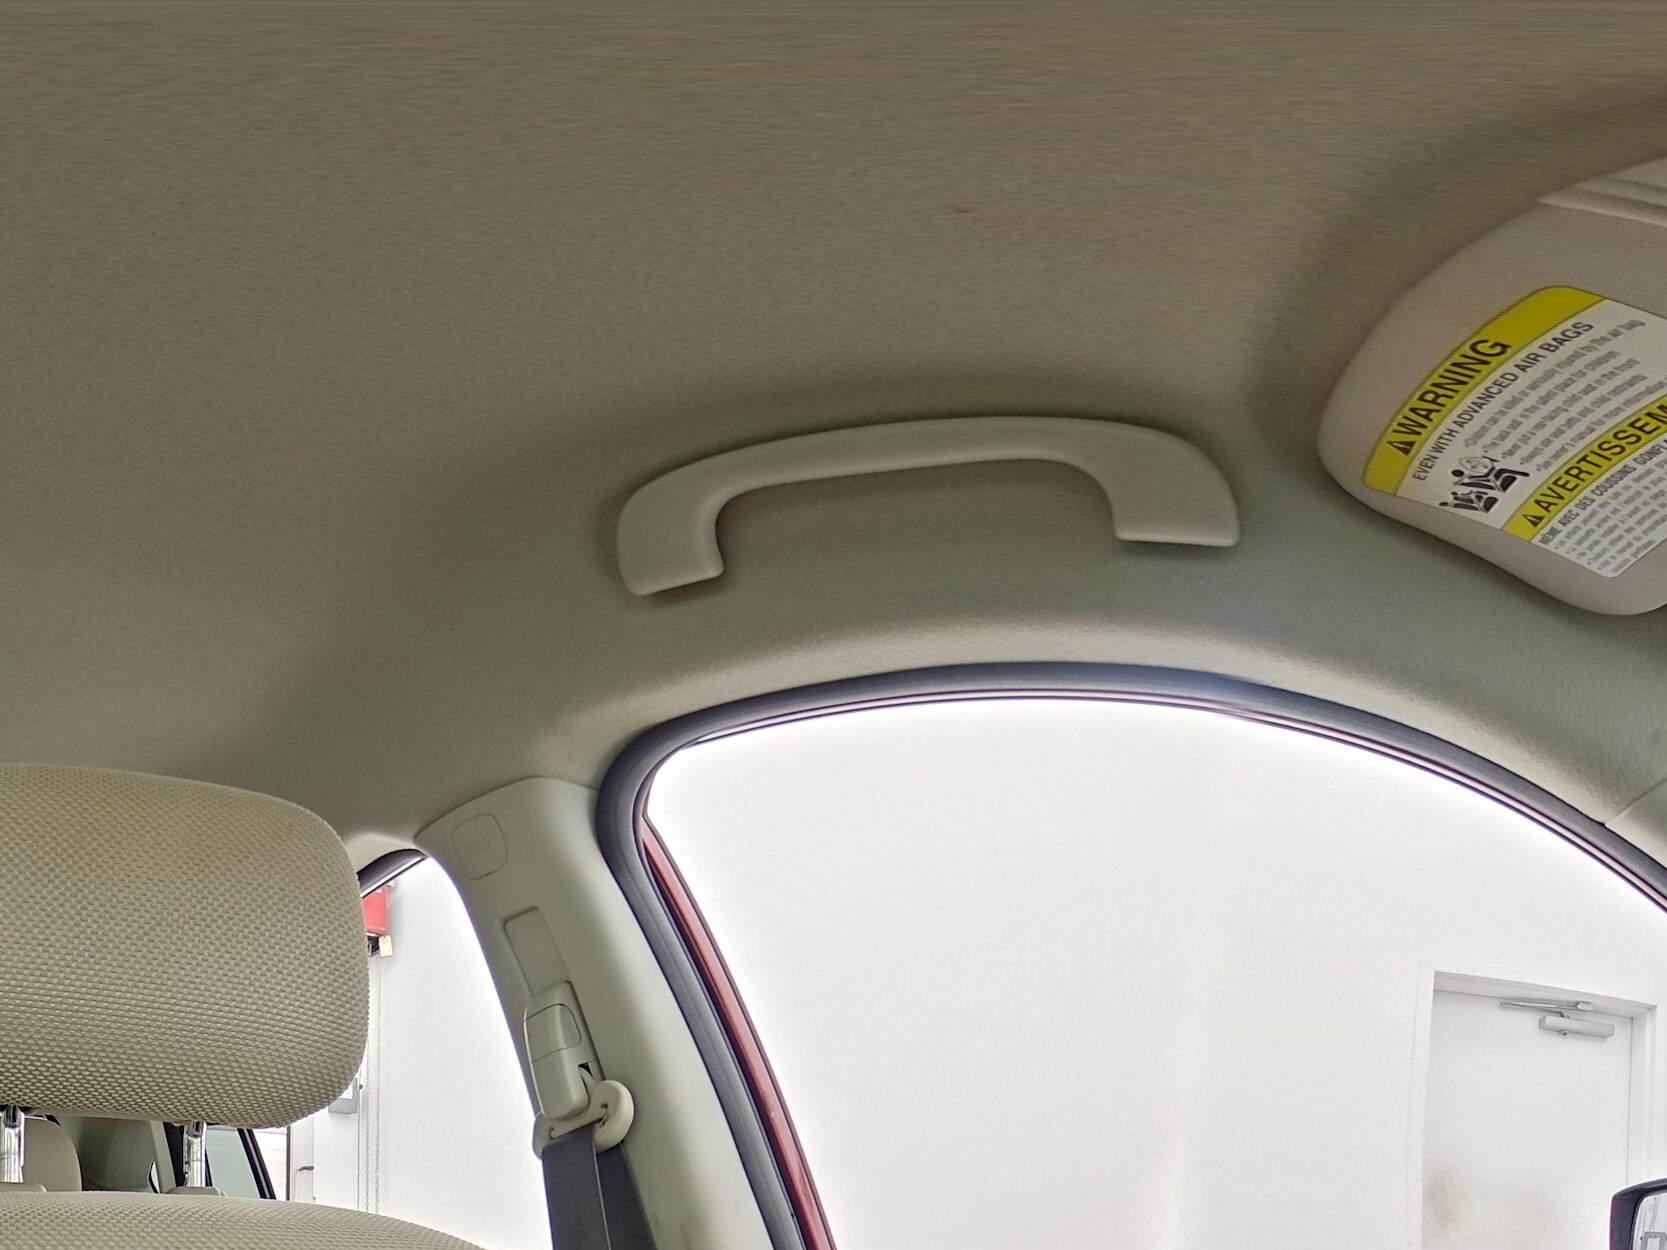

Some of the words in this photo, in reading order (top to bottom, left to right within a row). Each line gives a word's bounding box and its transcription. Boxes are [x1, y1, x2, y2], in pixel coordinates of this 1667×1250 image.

[1392, 339, 1512, 437] WARNING
[1412, 454, 1439, 481] EVEN
[1429, 429, 1459, 454] WITH
[1453, 371, 1519, 429] ADVANCED
[1514, 352, 1547, 373] AIR
[1538, 321, 1594, 353] BAGS
[1558, 510, 1580, 527] AVEC
[1574, 496, 1596, 512] DES
[1591, 464, 1637, 497] COUSSINS
